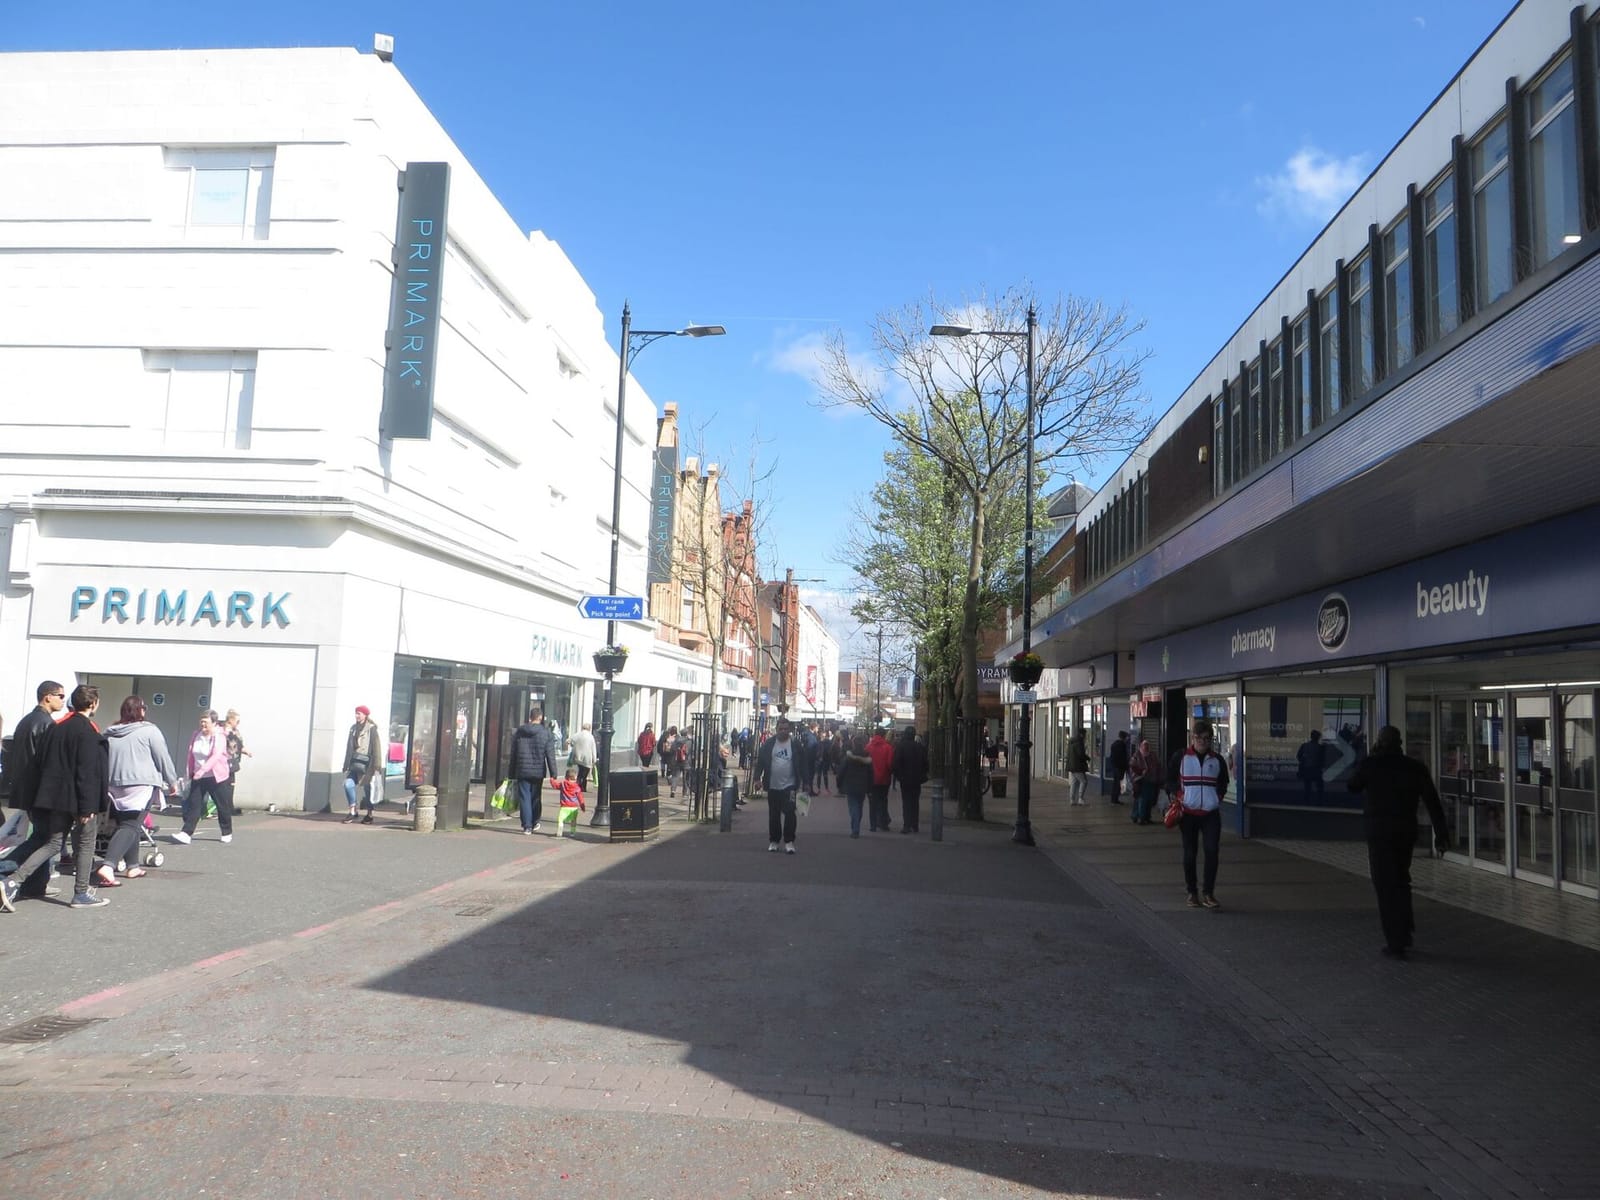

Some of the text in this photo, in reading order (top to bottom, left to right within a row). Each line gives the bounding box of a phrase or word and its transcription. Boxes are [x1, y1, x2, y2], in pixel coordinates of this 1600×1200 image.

[400, 220, 434, 385] PRIMARK
[656, 475, 671, 556] PRIMARK
[70, 585, 292, 629] PRIMARK
[1416, 569, 1489, 618] beauty
[531, 634, 583, 668] PRIMARK
[1231, 625, 1276, 659] pharmacy
